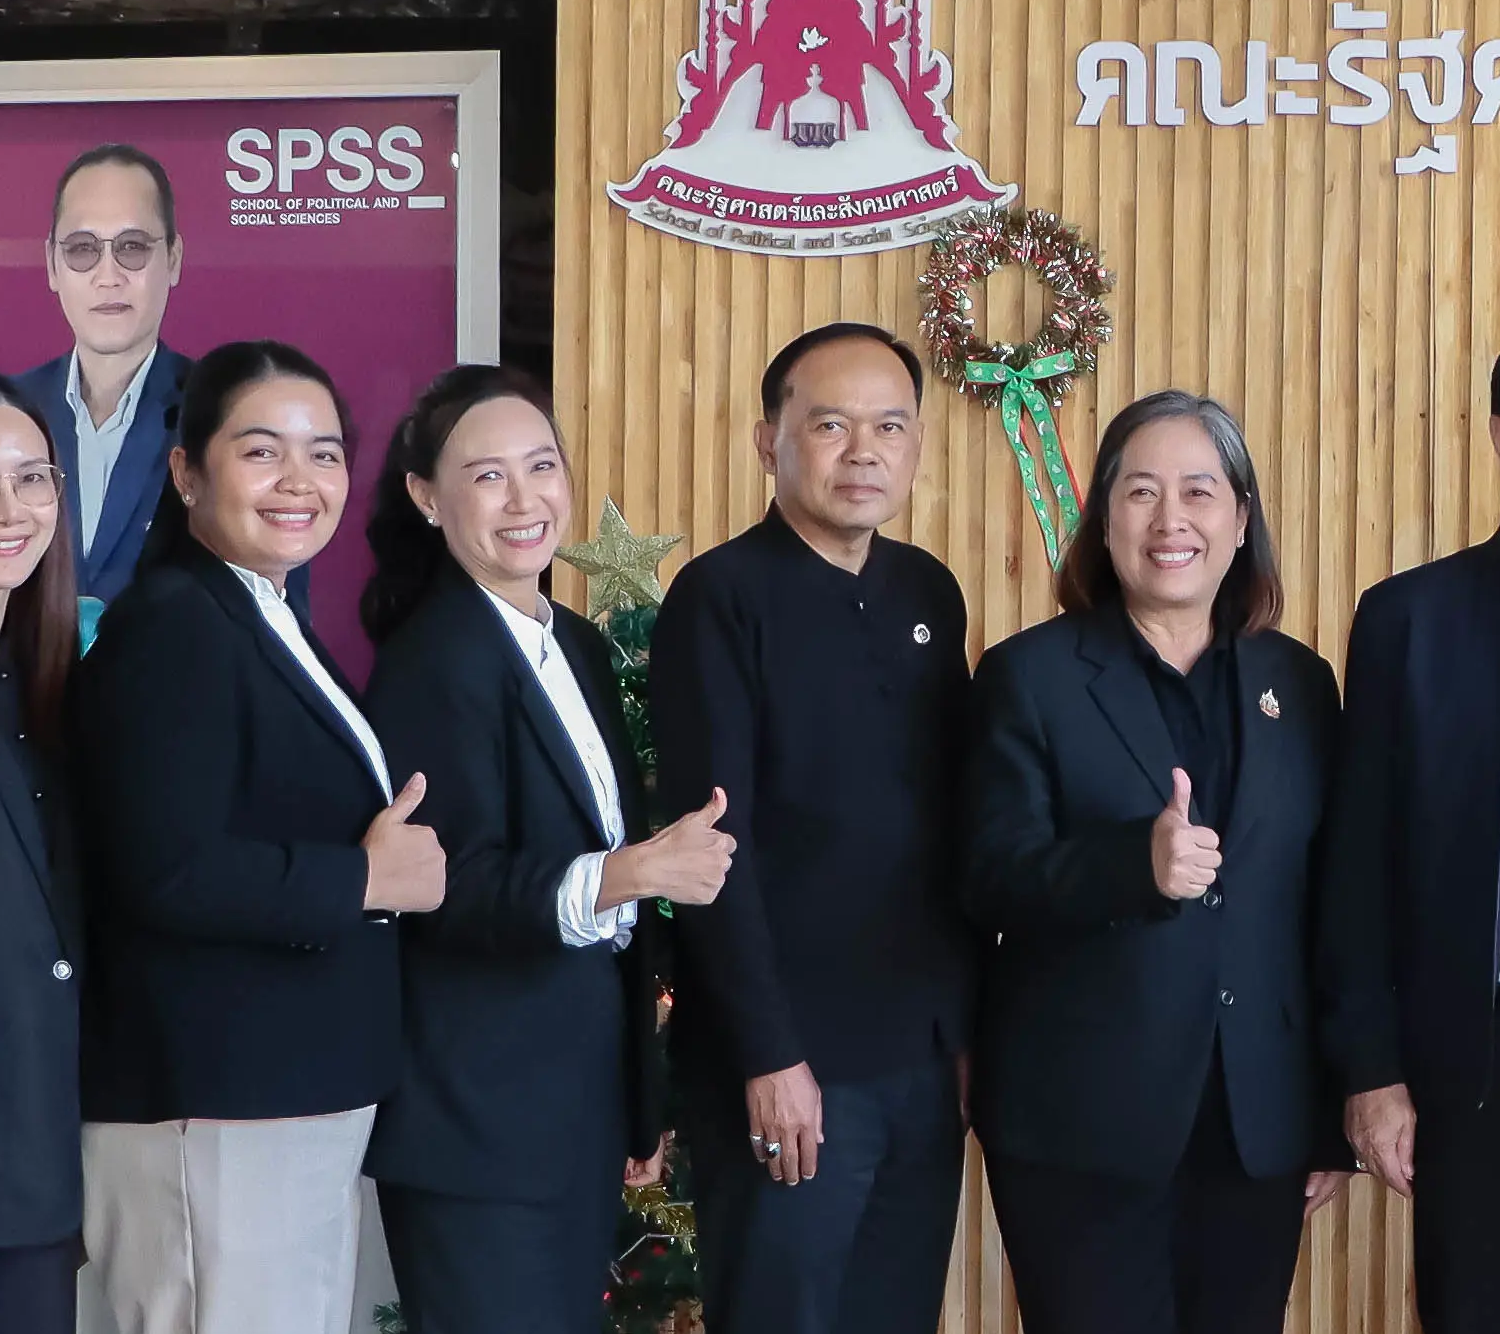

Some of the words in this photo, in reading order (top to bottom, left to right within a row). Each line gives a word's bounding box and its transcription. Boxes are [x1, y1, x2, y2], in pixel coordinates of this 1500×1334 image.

[225, 124, 425, 195] SPSS
[230, 197, 282, 210] SCHOOL
[285, 197, 302, 210] OF
[306, 196, 369, 210] POLITICAL
[373, 196, 400, 209] AND
[655, 166, 960, 222] คณะรัฐศาสตร์และสังคมศาสตร์
[230, 212, 275, 226] SOCIAL
[280, 212, 341, 225] SCIENCES
